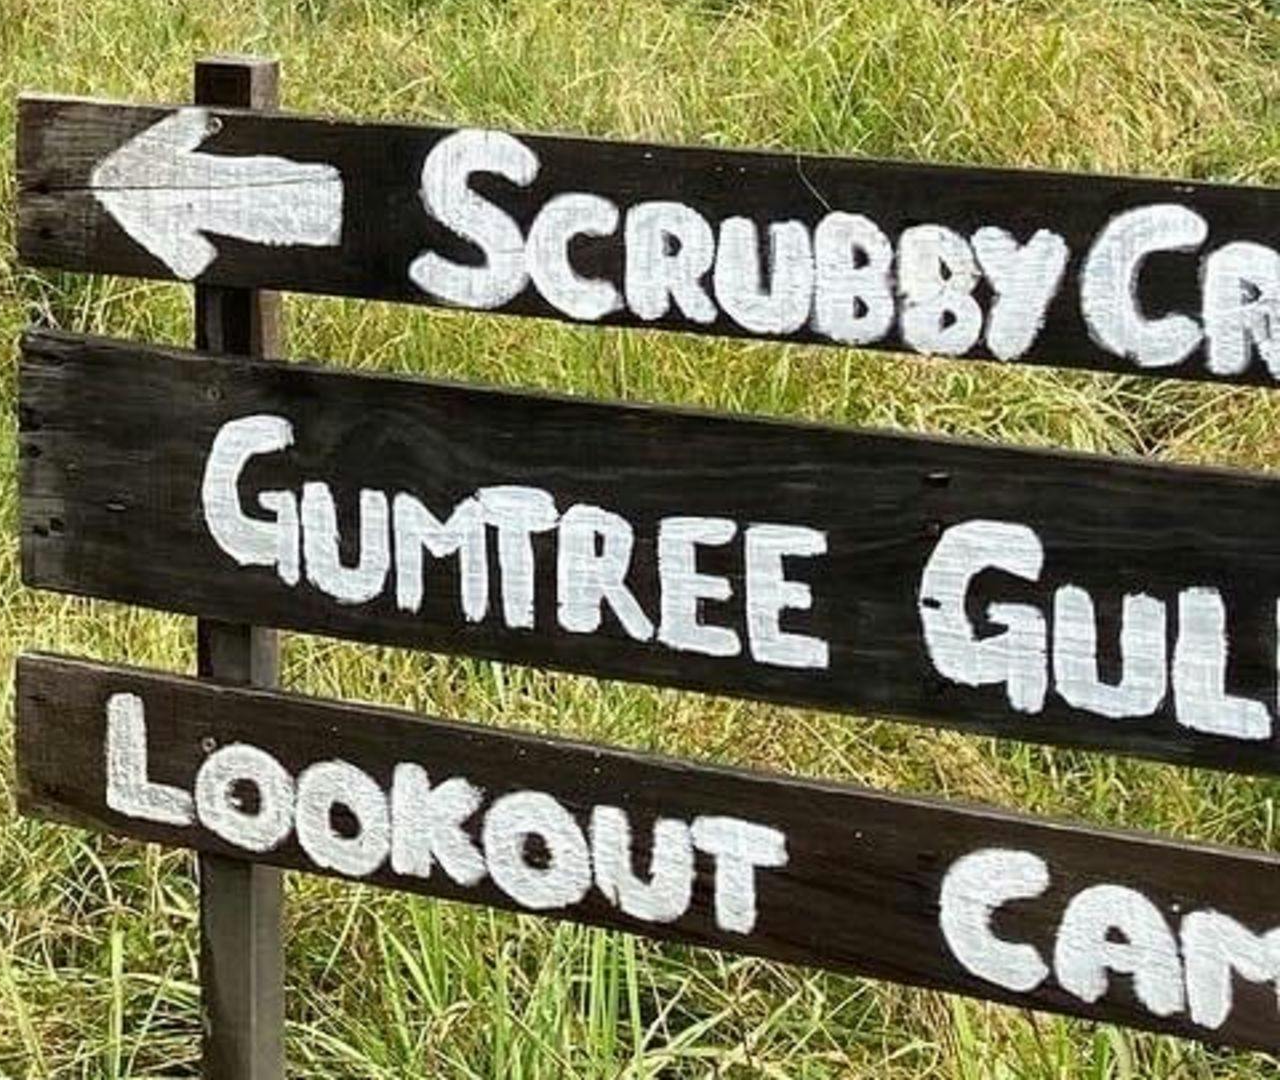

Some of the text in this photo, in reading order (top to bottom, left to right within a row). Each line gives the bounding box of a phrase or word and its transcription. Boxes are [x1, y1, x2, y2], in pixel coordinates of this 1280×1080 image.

[408, 127, 1071, 362] SCRUBBY
[200, 414, 830, 669] GUMTREE
[105, 692, 789, 934] LOOKOUT
